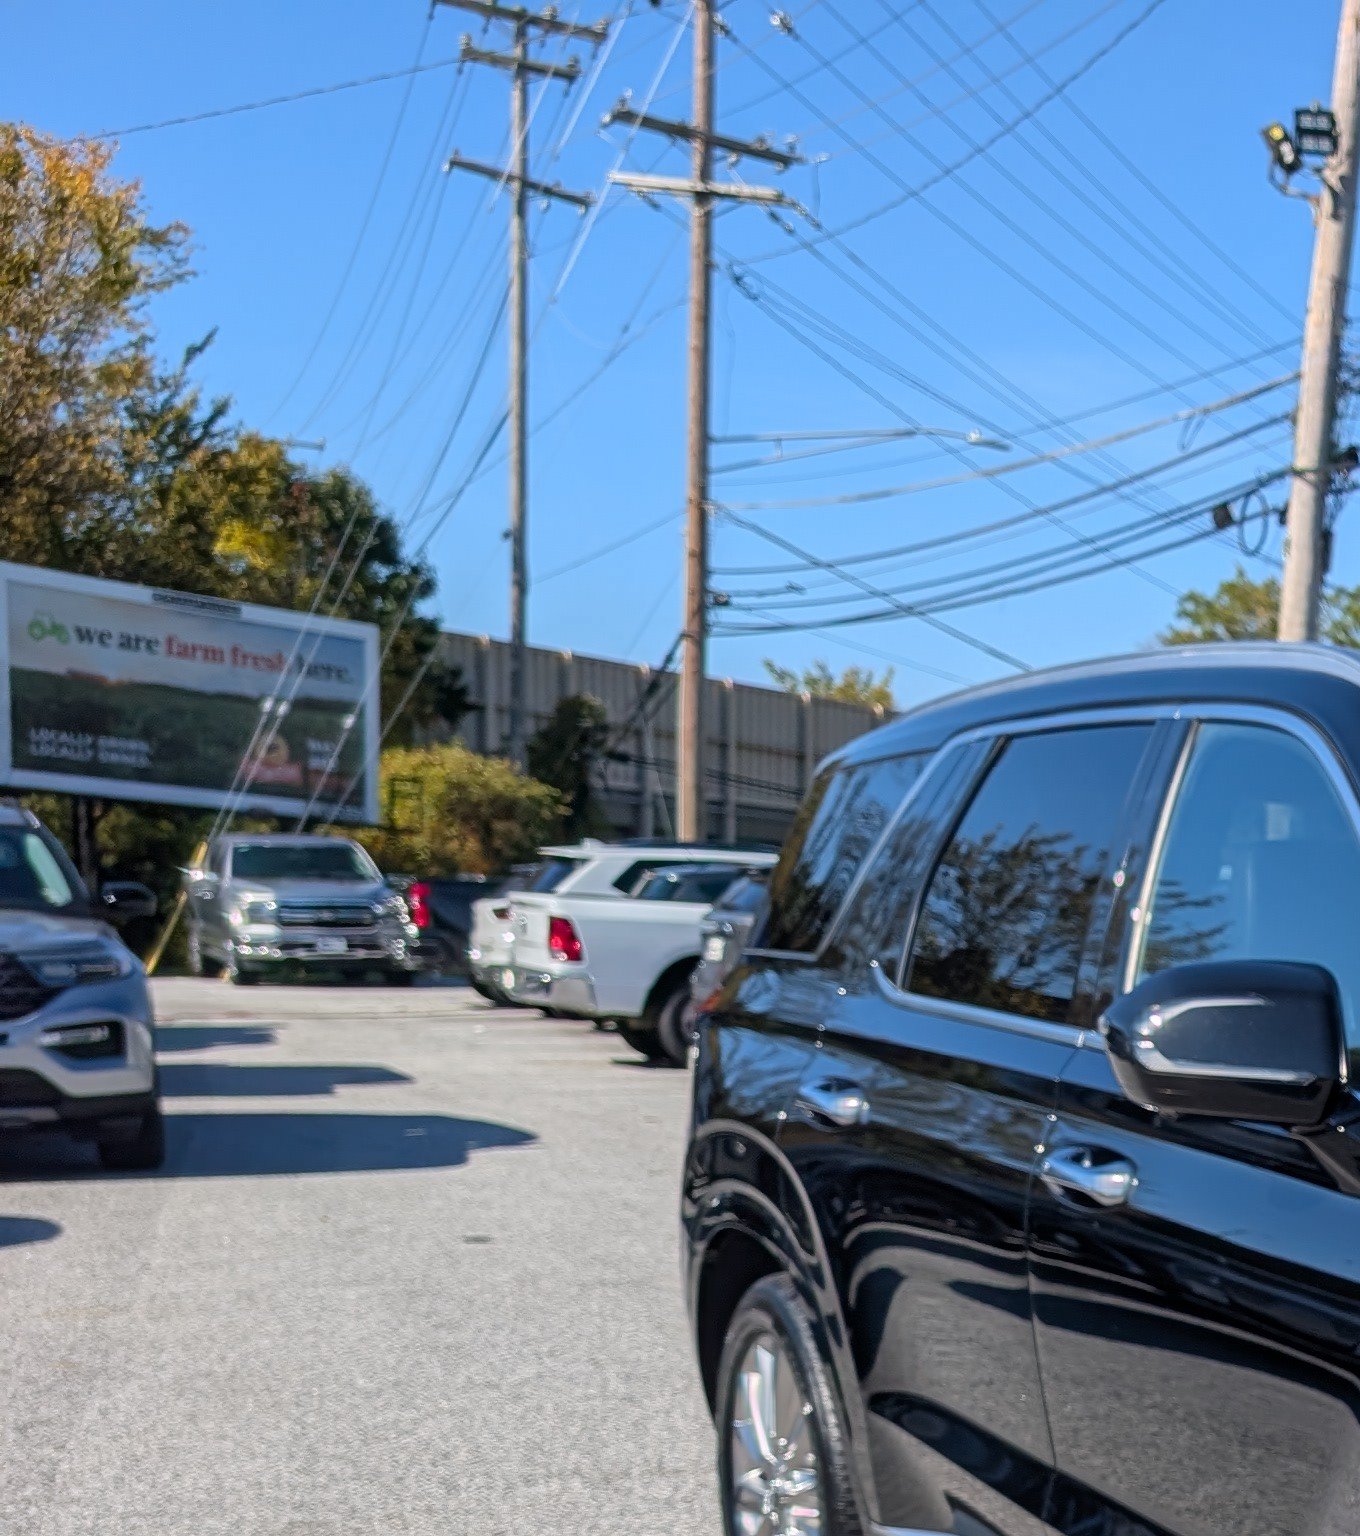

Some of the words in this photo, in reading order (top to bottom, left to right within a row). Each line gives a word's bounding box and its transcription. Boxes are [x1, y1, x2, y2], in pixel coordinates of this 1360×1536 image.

[75, 625, 112, 648] we
[118, 631, 160, 656] are
[164, 635, 226, 665] farm
